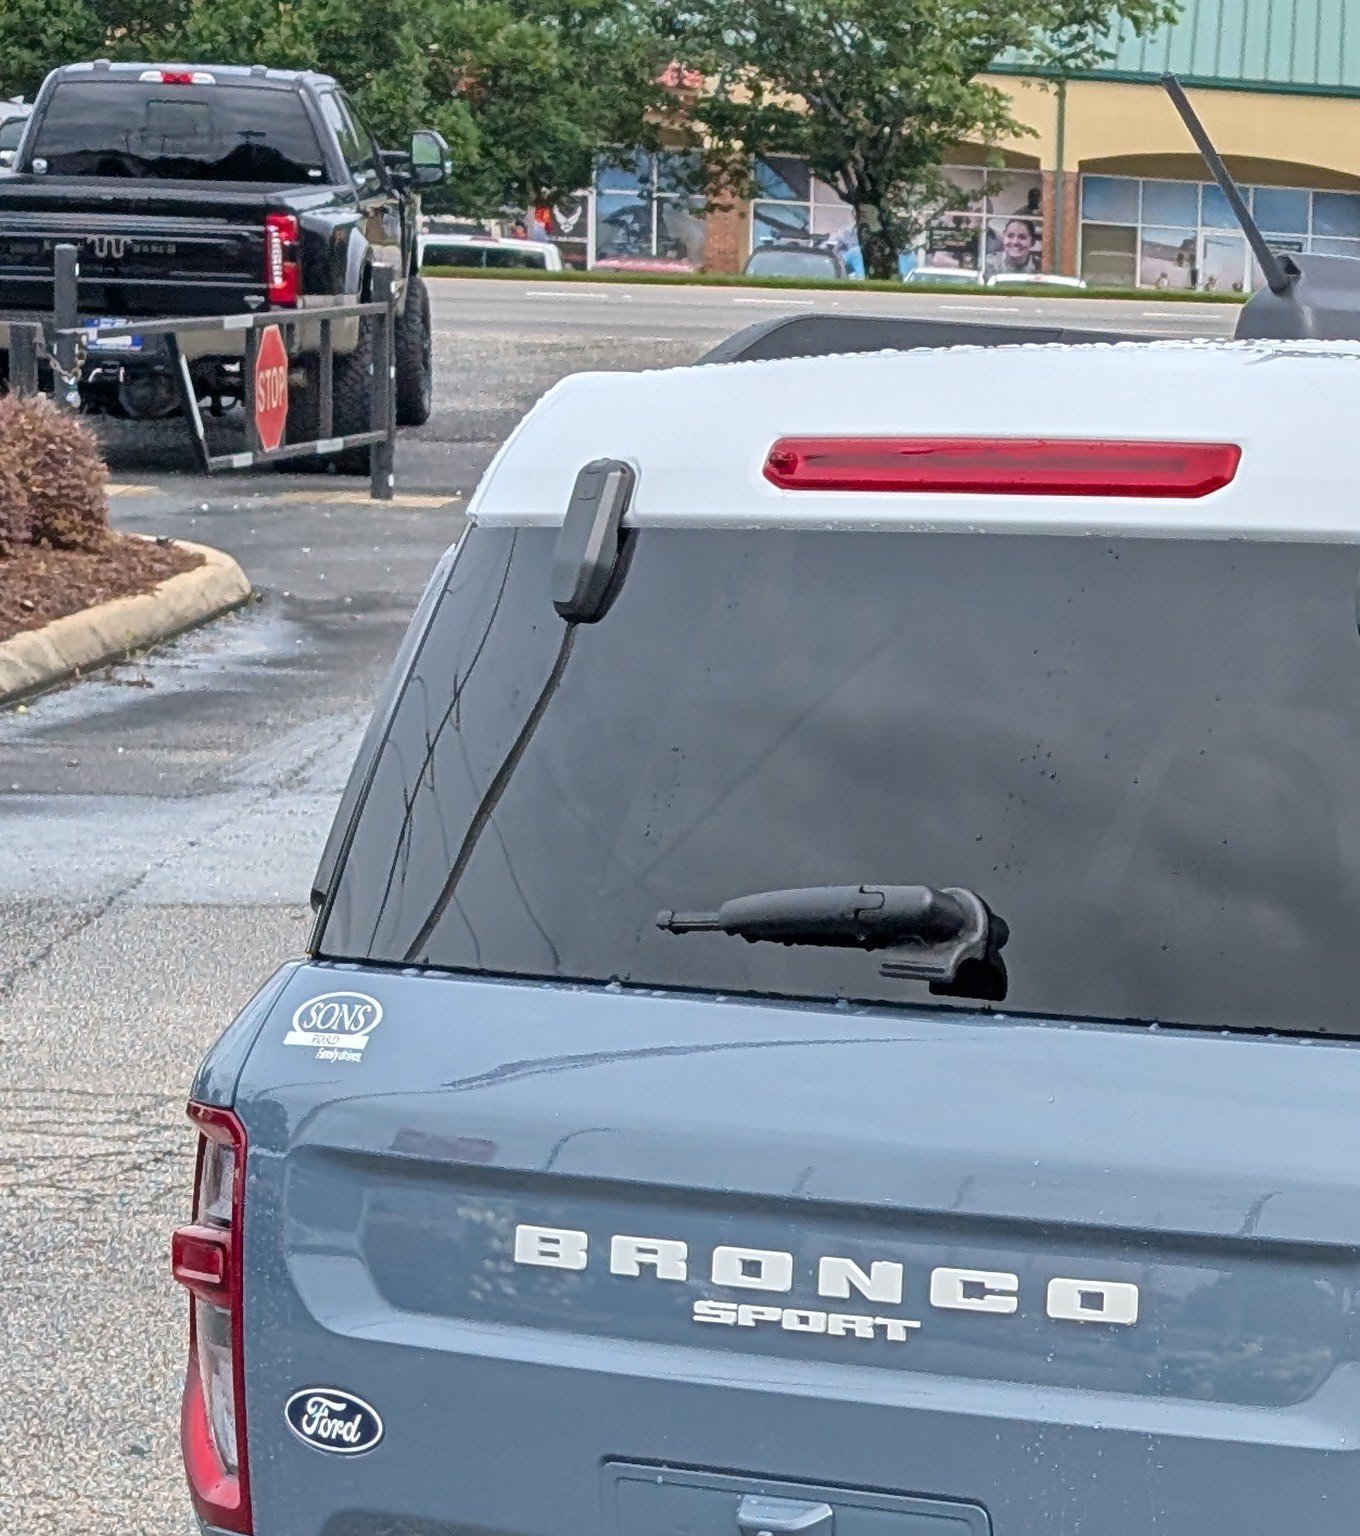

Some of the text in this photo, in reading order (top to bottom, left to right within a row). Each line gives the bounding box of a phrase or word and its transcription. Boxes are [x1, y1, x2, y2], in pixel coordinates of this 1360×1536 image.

[258, 365, 285, 413] STOP
[303, 1002, 372, 1032] SONS
[514, 1223, 1139, 1326] BRONCO
[692, 1300, 921, 1342] SPORT
[302, 1396, 362, 1443] Ford
